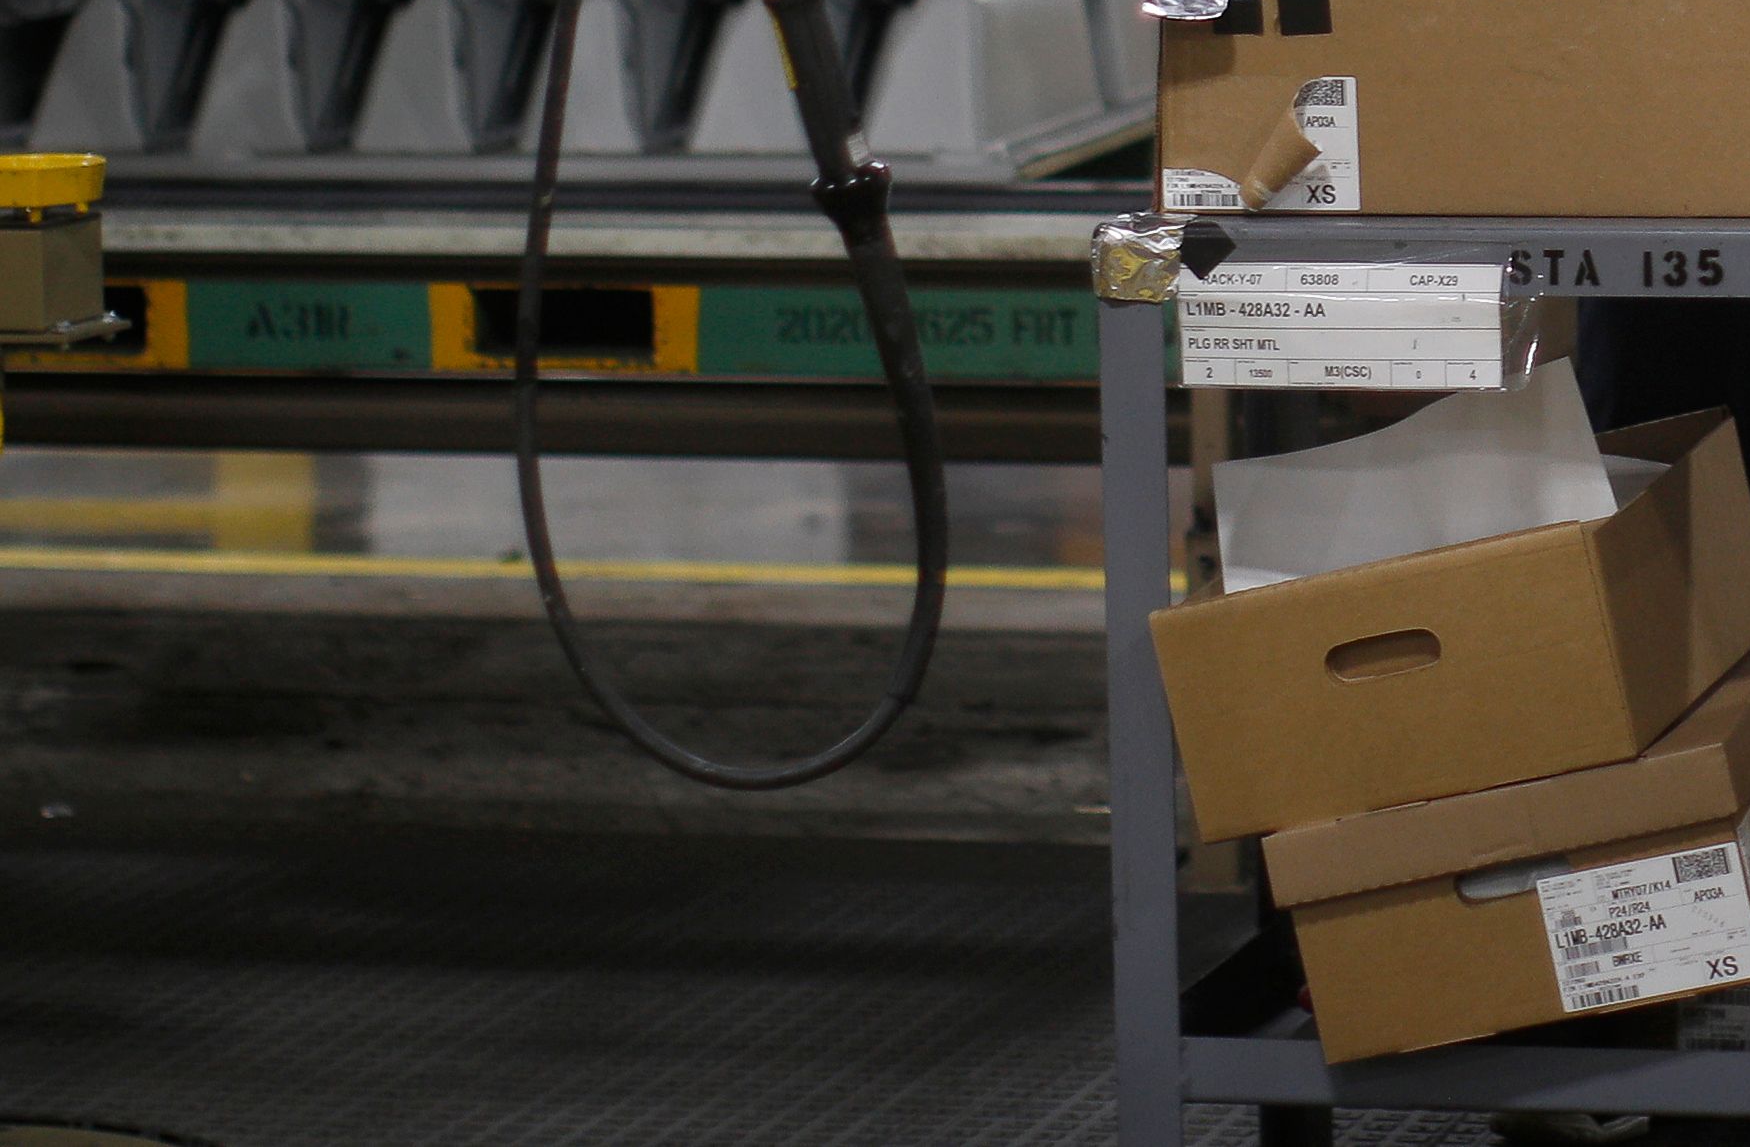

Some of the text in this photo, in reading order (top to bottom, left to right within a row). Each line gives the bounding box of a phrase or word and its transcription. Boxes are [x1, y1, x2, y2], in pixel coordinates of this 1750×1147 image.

[1306, 184, 1337, 205] XS
[1508, 249, 1600, 287] STA
[1300, 273, 1340, 286] 63808
[1409, 274, 1459, 287] CAP-X29
[1238, 303, 1291, 318] 428A32
[1303, 303, 1327, 318] AA
[1188, 337, 1281, 351] PLG RR SHT MTL
[1205, 366, 1214, 379] 2
[1324, 365, 1372, 379] M3(CSC)
[1469, 369, 1477, 380] 4
[1555, 914, 1667, 949] L1MB-428A32-AA
[1706, 955, 1739, 980] XS
